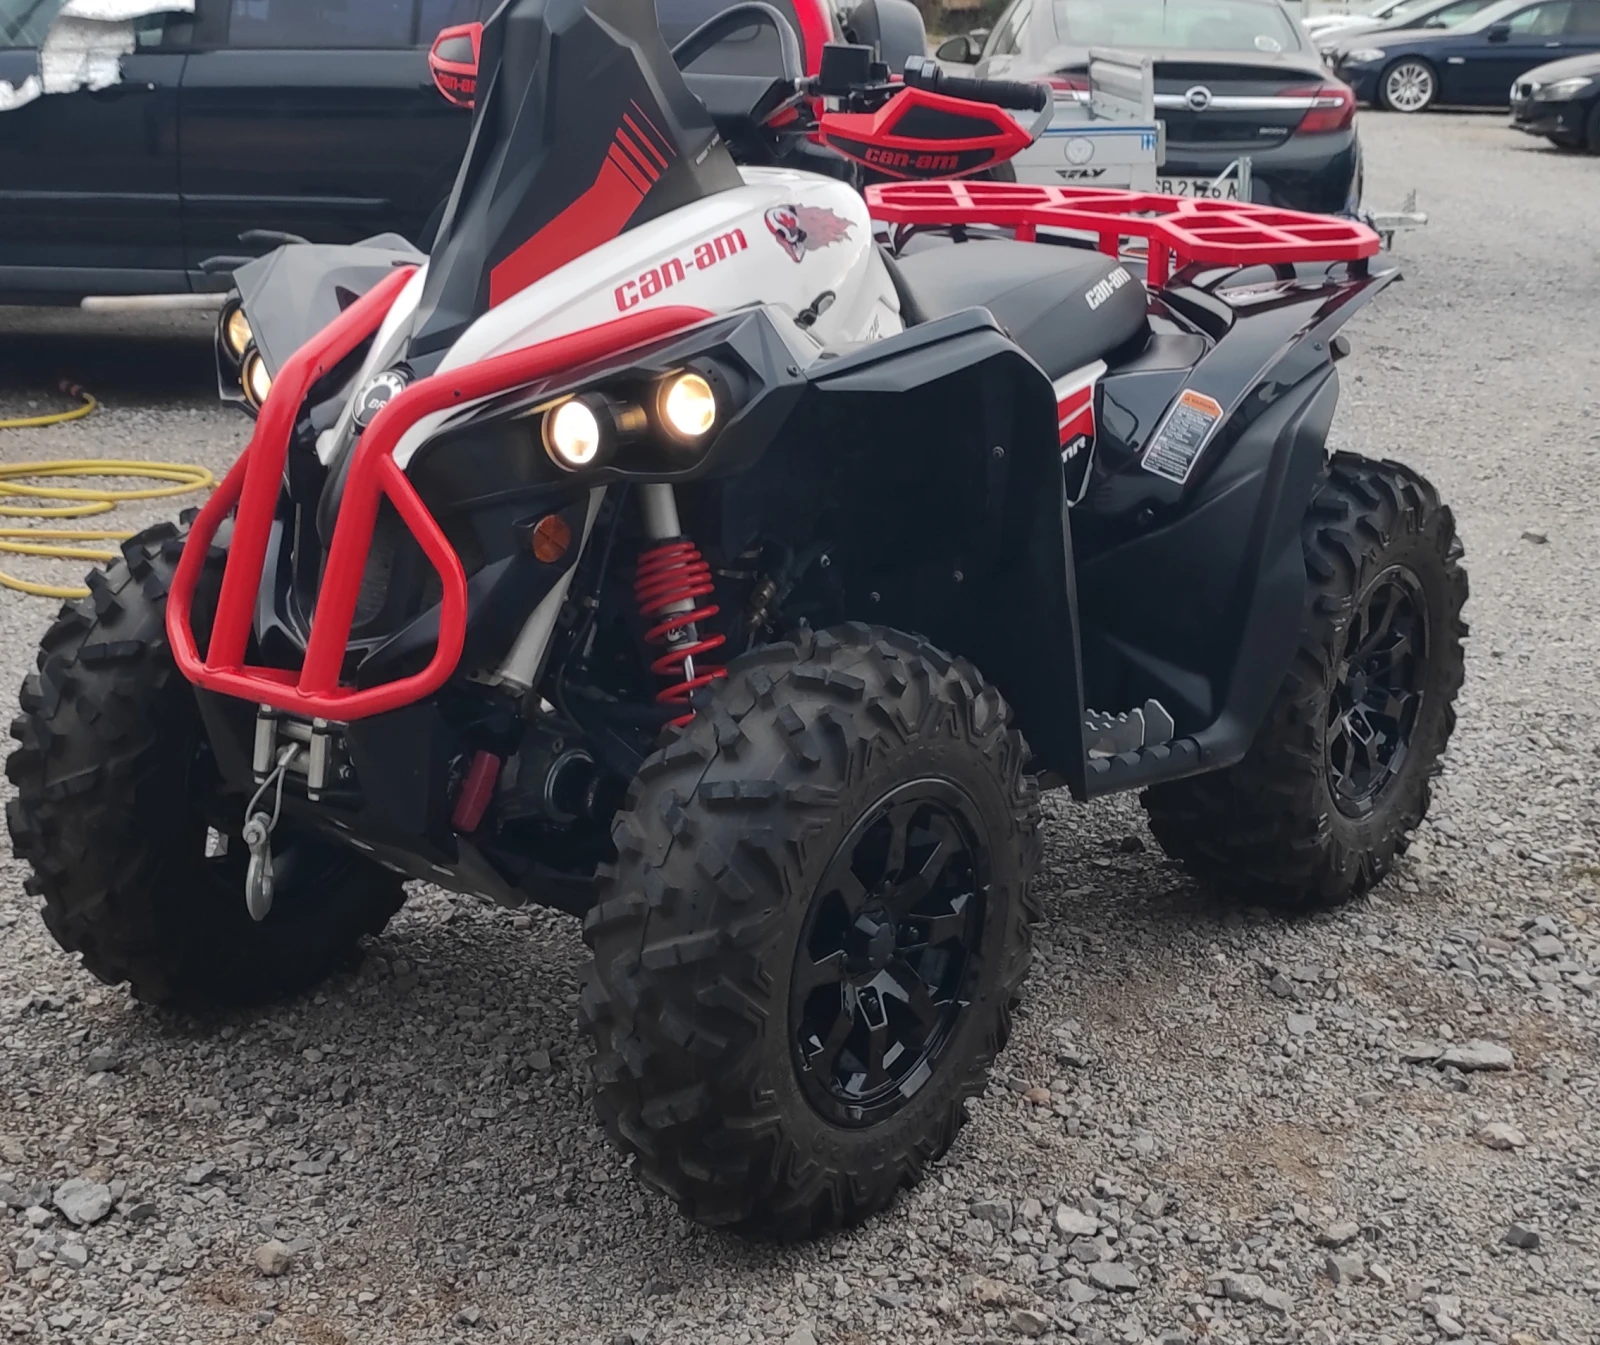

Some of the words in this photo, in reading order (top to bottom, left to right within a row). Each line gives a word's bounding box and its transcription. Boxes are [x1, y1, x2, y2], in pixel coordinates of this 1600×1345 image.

[865, 147, 959, 170] can-am
[614, 228, 748, 312] can-am
[1085, 266, 1131, 310] can-am
